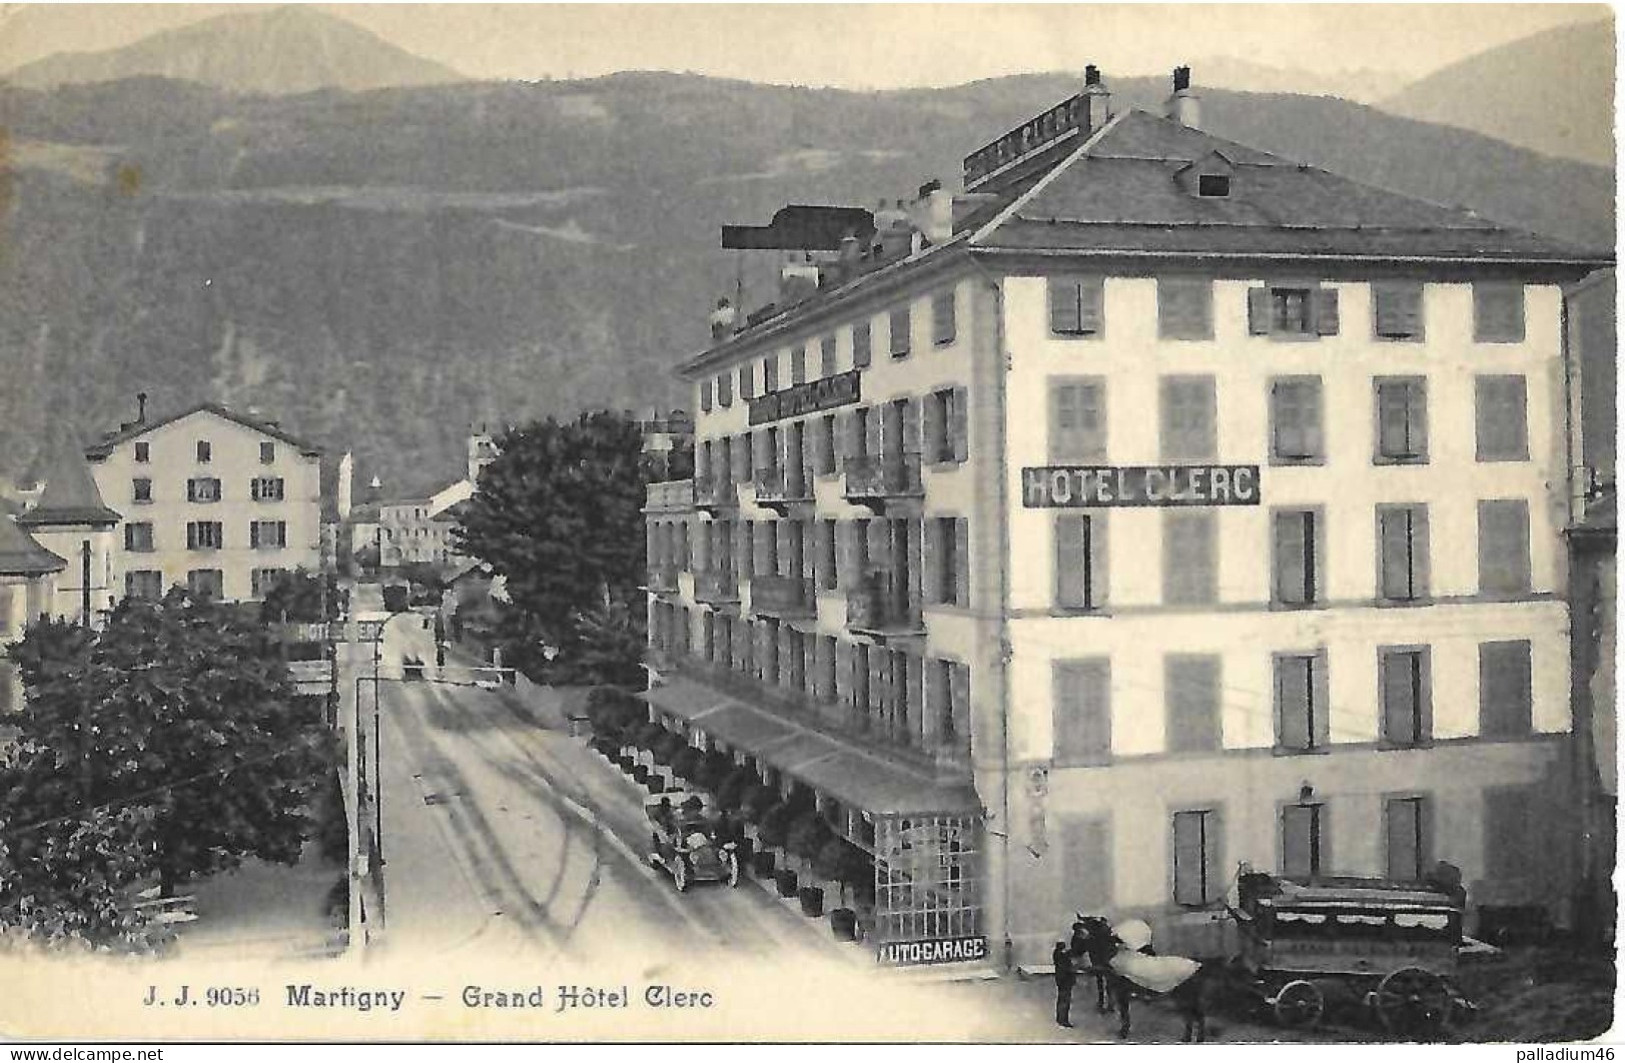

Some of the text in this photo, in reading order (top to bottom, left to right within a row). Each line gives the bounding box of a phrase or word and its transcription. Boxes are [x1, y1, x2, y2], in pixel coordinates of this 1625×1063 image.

[1027, 468, 1253, 504] HOTEL CLERC
[143, 985, 166, 1006] J.
[174, 985, 198, 1006] J.
[285, 984, 405, 1012] Martigny
[462, 984, 543, 1008] Grand
[557, 984, 628, 1012] Hôtel
[645, 984, 713, 1008] Clerc
